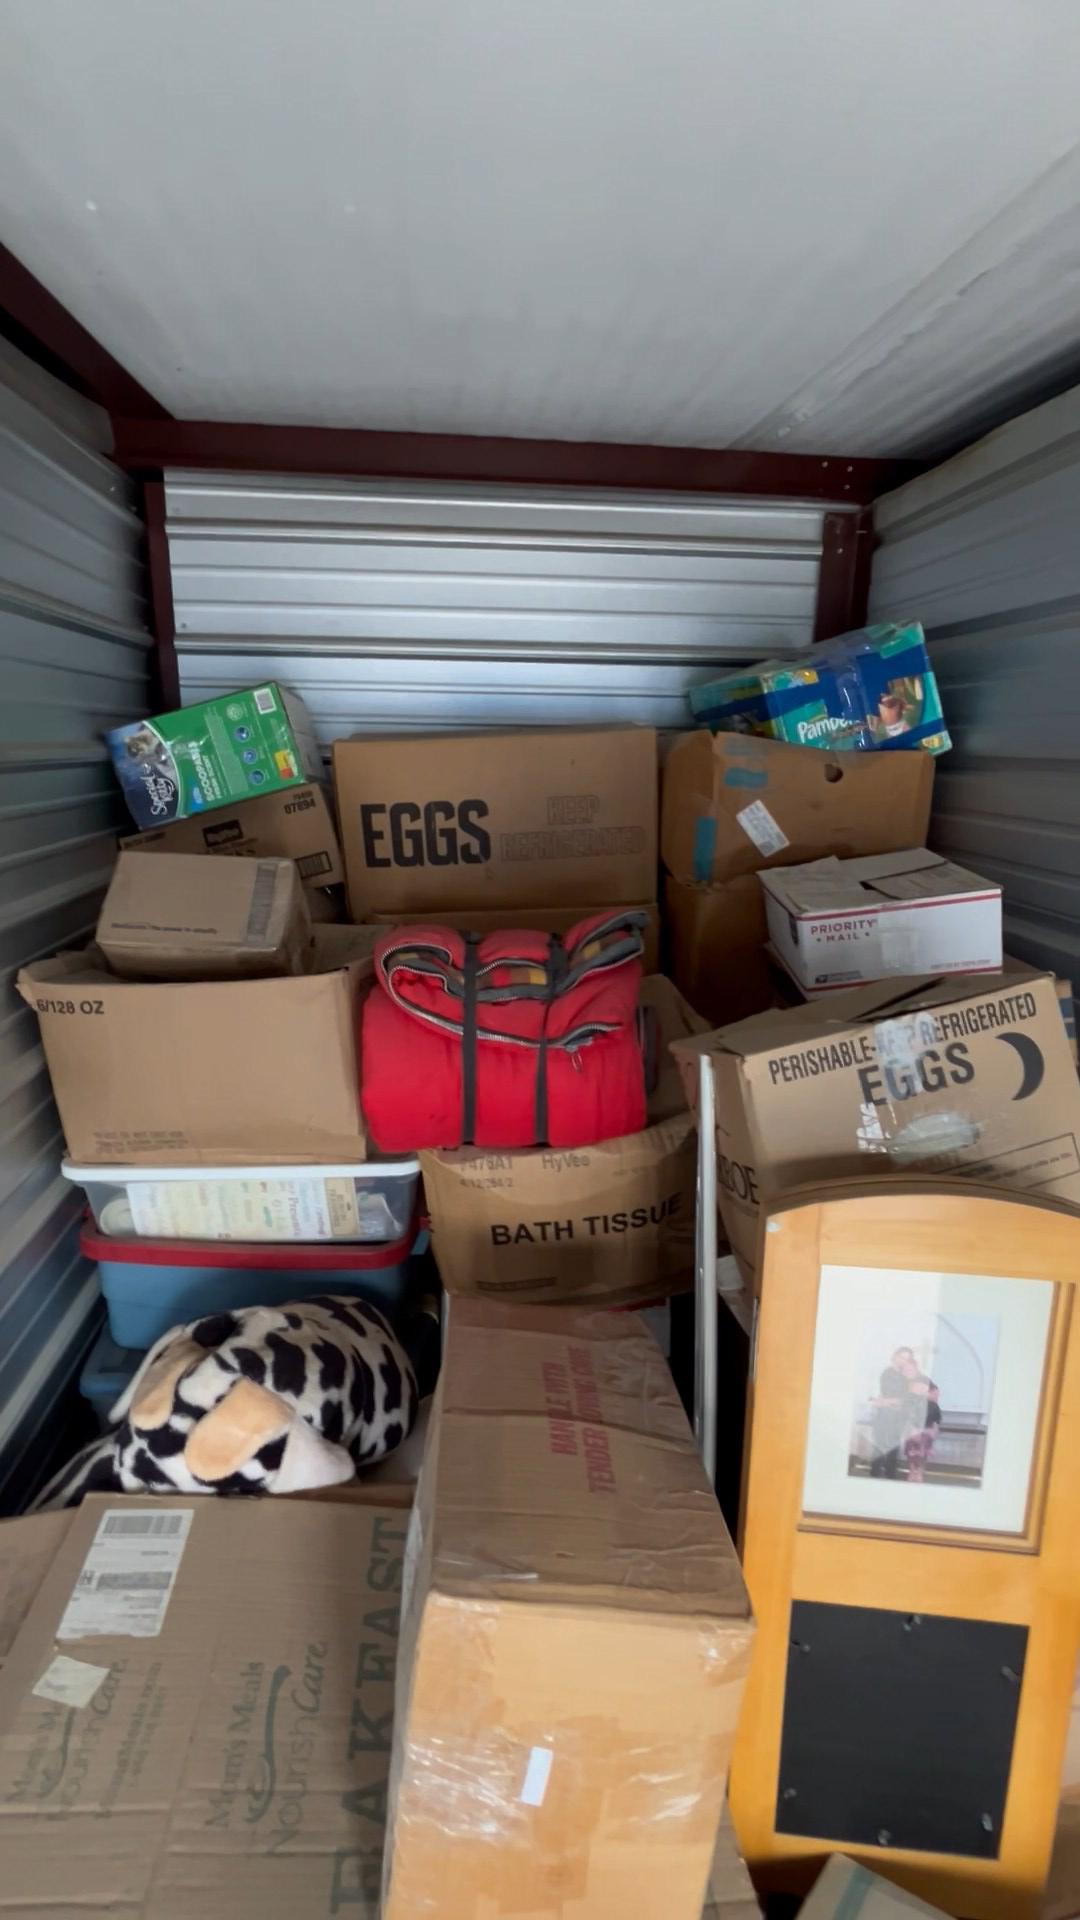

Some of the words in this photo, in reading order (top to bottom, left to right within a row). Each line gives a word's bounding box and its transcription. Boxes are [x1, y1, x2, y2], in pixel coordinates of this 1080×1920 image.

[360, 799, 491, 868] EGGS
[811, 920, 874, 935] PRIORITY
[826, 932, 861, 942] MAIL
[37, 1000, 75, 1015] 6/128
[80, 1000, 105, 1015] OZ
[858, 1042, 975, 1106] EGGS
[491, 1219, 574, 1245] BATH
[583, 1192, 684, 1236] TISSUE
[583, 1427, 617, 1494] TENDER
